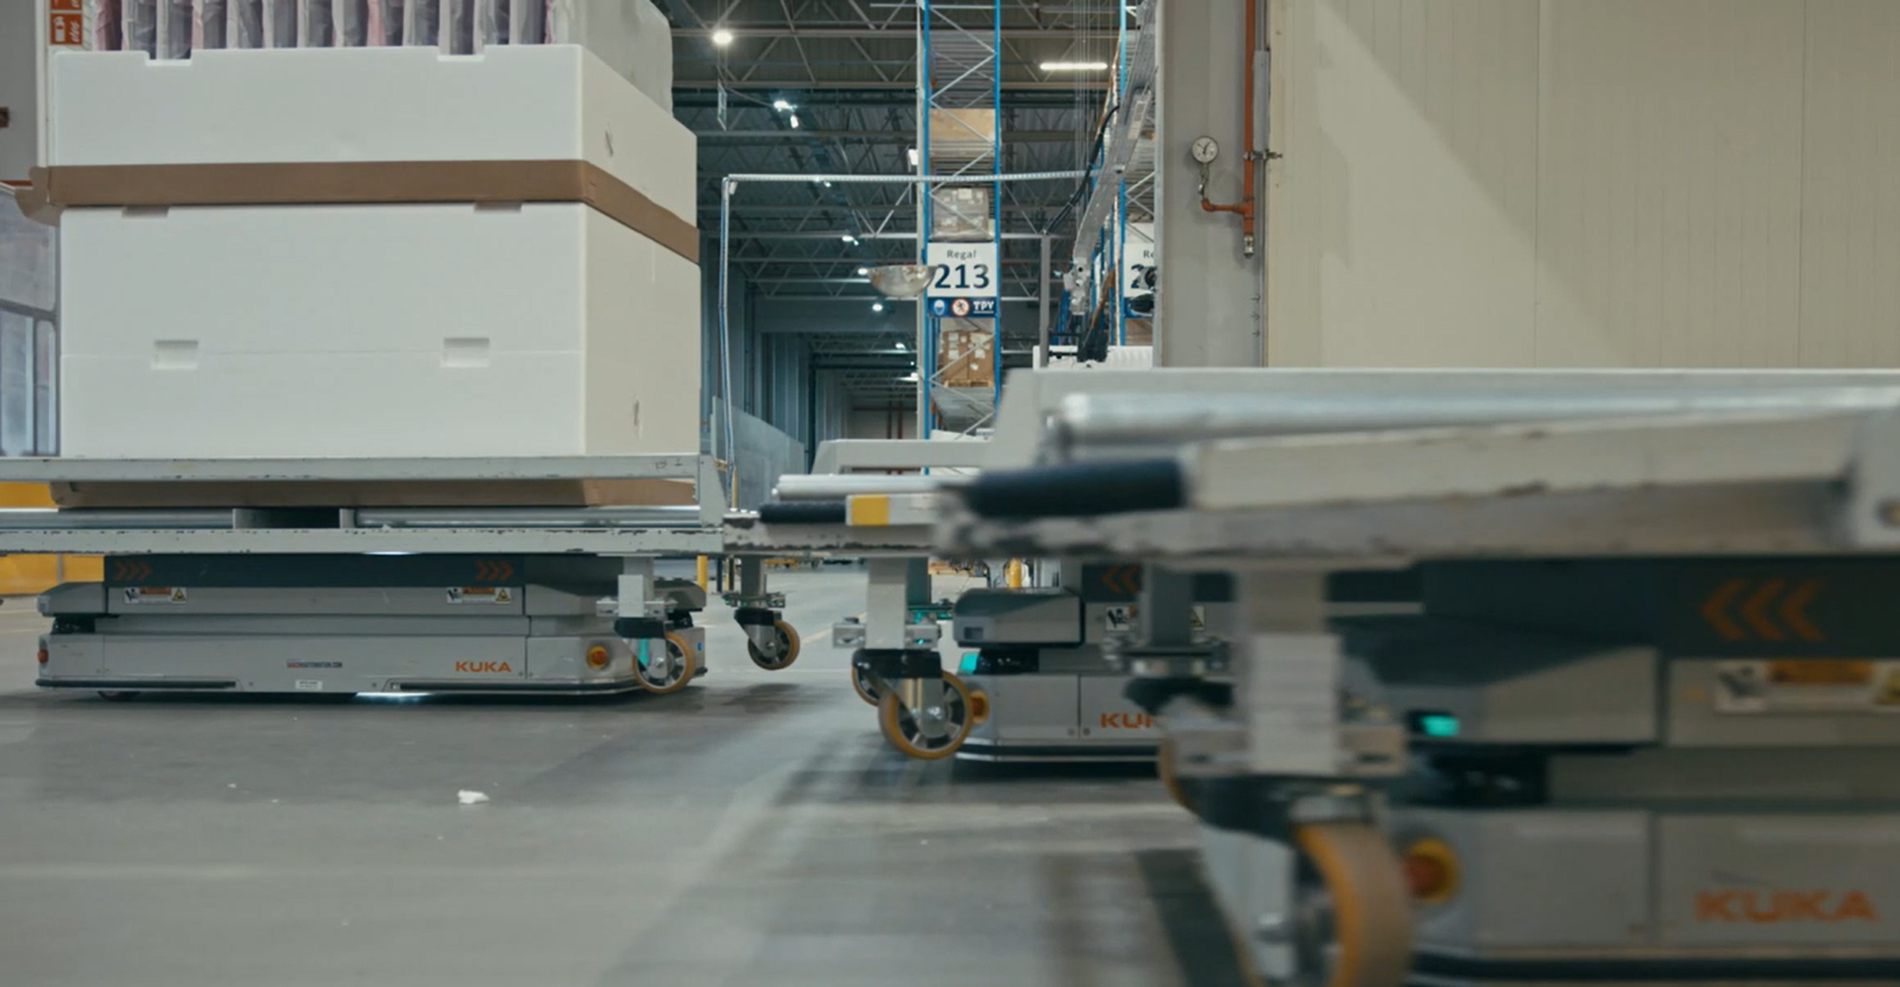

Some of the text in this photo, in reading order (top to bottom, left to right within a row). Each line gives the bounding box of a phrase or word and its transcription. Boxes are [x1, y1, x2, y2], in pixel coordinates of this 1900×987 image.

[946, 249, 977, 260] Regal
[934, 263, 989, 289] 213
[455, 661, 512, 673] KUKA
[1695, 890, 1880, 923] KUKA
